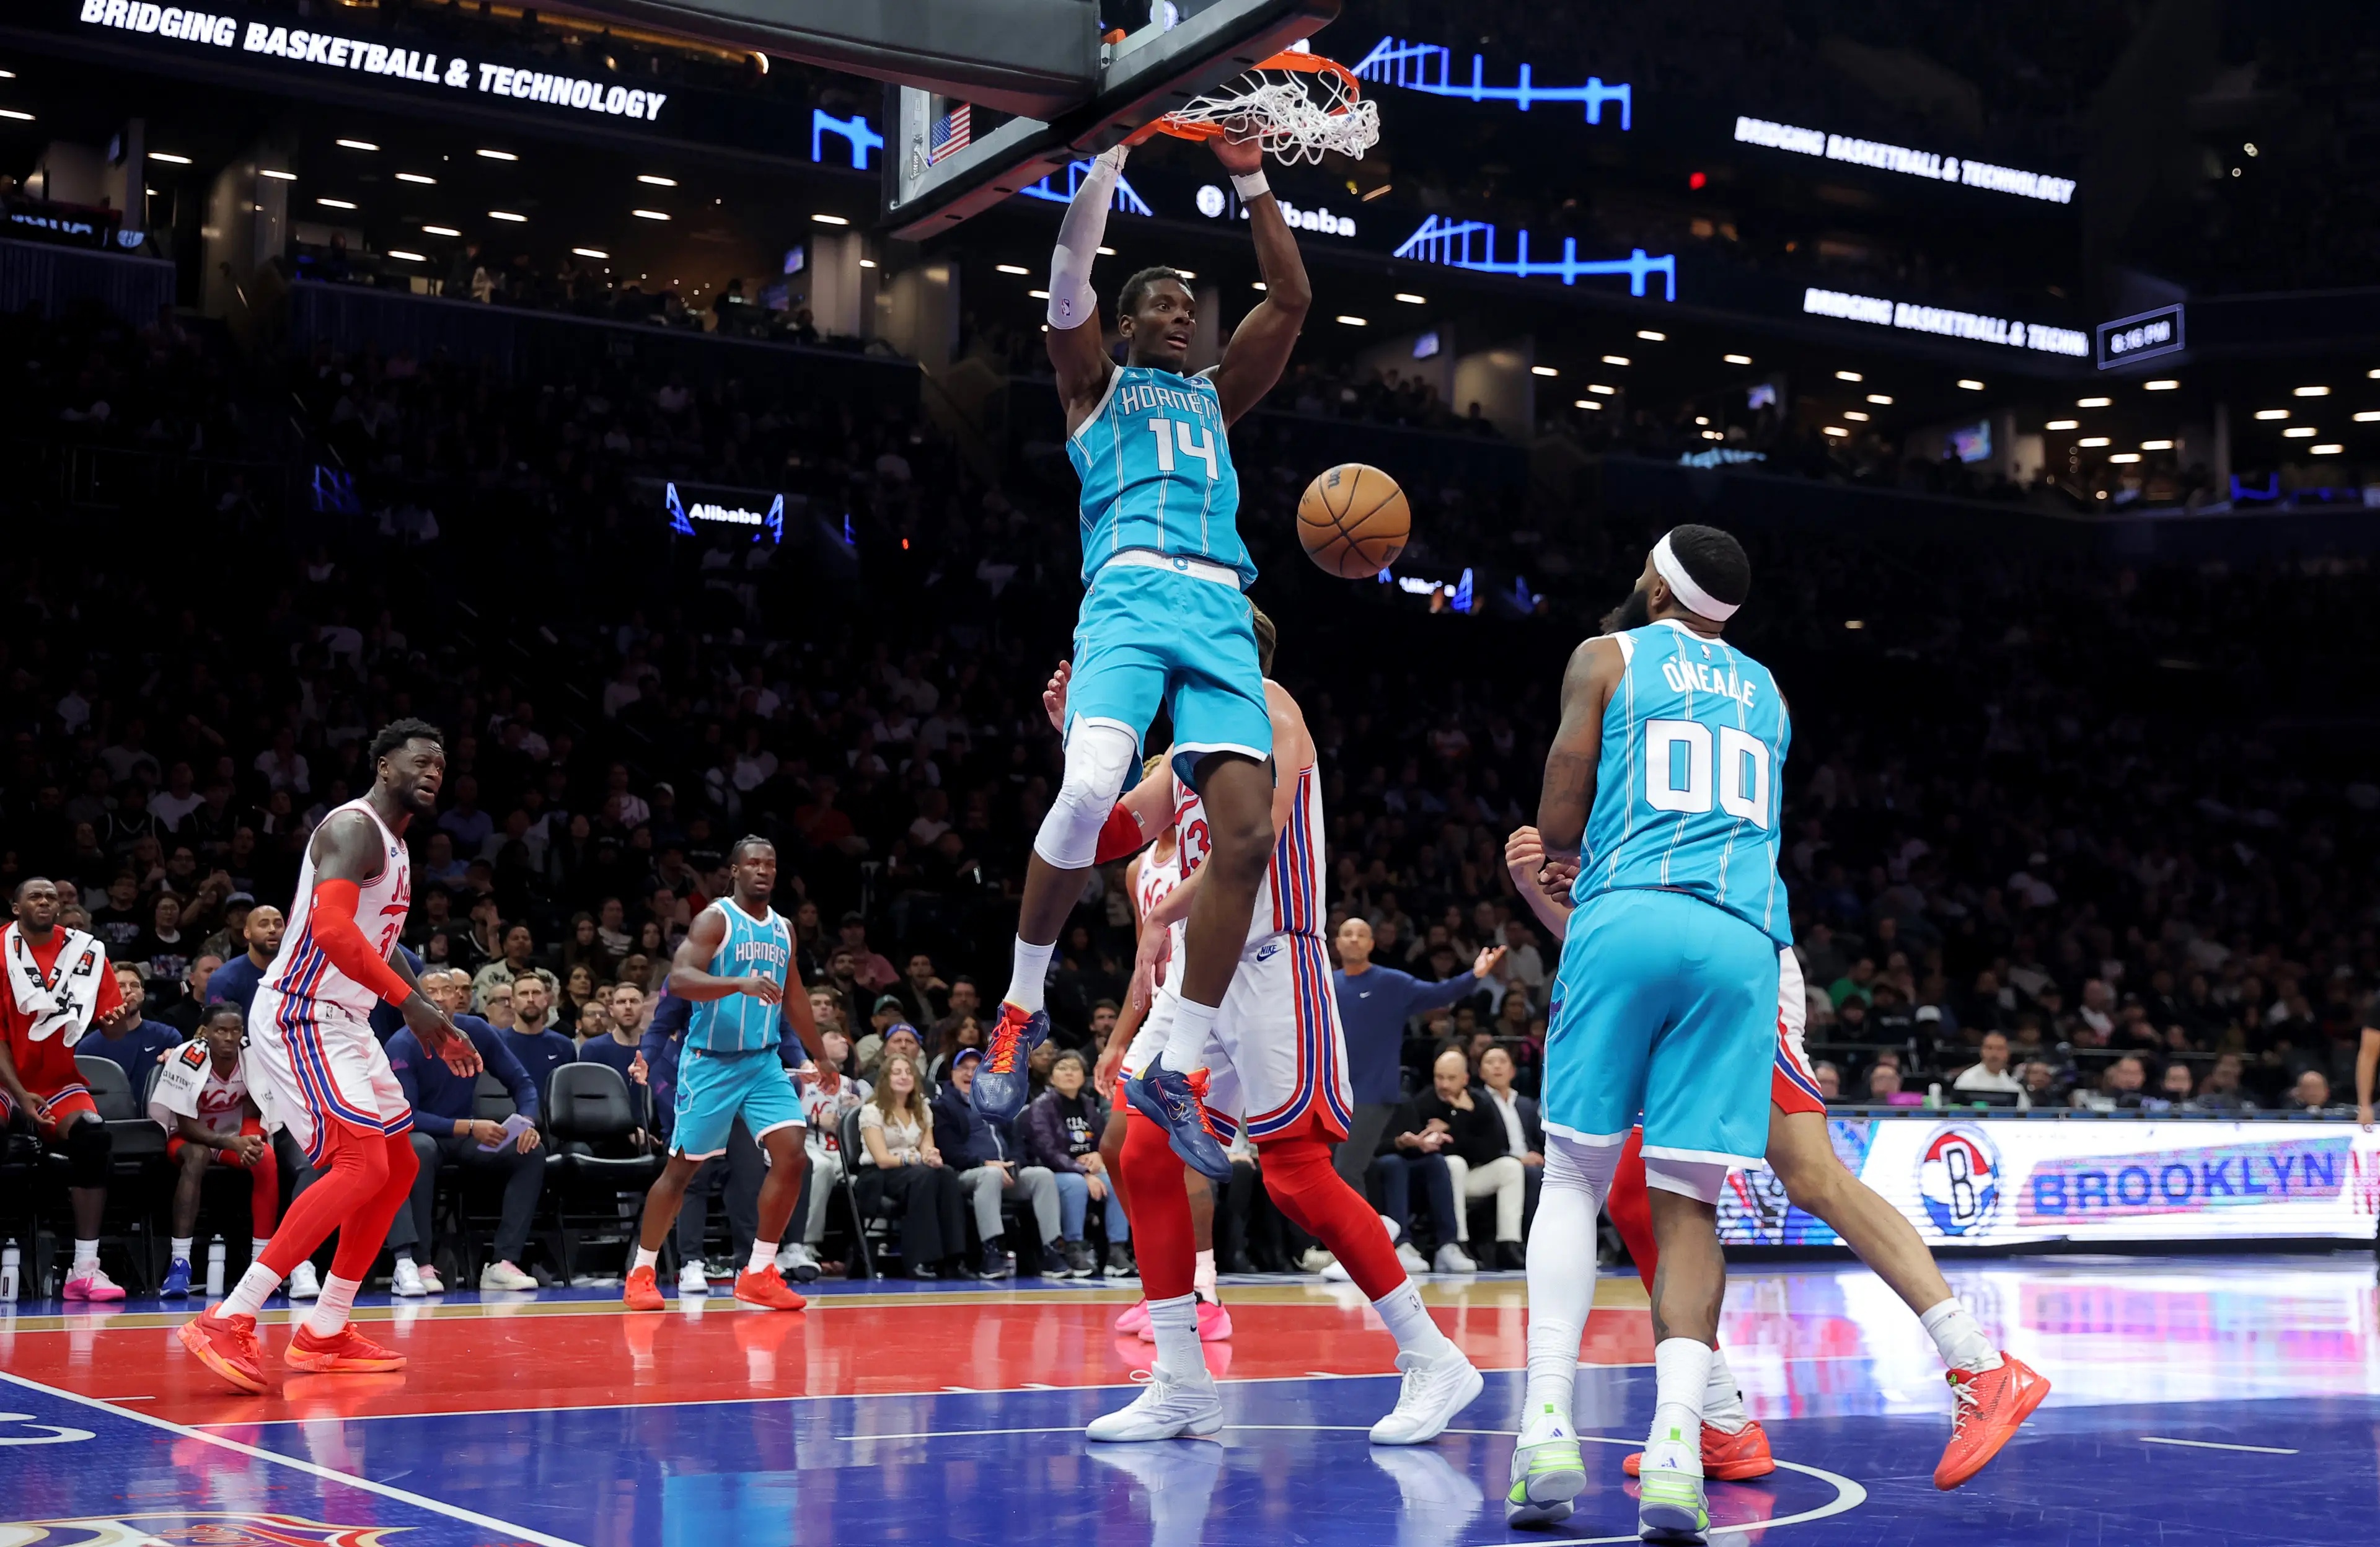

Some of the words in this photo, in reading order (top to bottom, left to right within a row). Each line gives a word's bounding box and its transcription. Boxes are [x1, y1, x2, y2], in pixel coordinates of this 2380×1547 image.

[80, 0, 237, 48] BRIDGING
[243, 21, 439, 84] BASKETBALL
[444, 58, 470, 89] &
[478, 63, 666, 121] TECHNOLOGY
[1826, 133, 1941, 180] BASKETBALL
[1121, 385, 1219, 433] HORNETS
[1148, 418, 1220, 481] 14
[689, 502, 762, 526] Alibaba
[1645, 718, 1771, 831] 00
[1179, 818, 1211, 881] 13
[735, 940, 787, 969] HORNETS
[1260, 945, 1277, 956] NIKE
[1946, 1147, 1977, 1220] B
[2032, 1152, 2335, 1216] BROOKLYN
